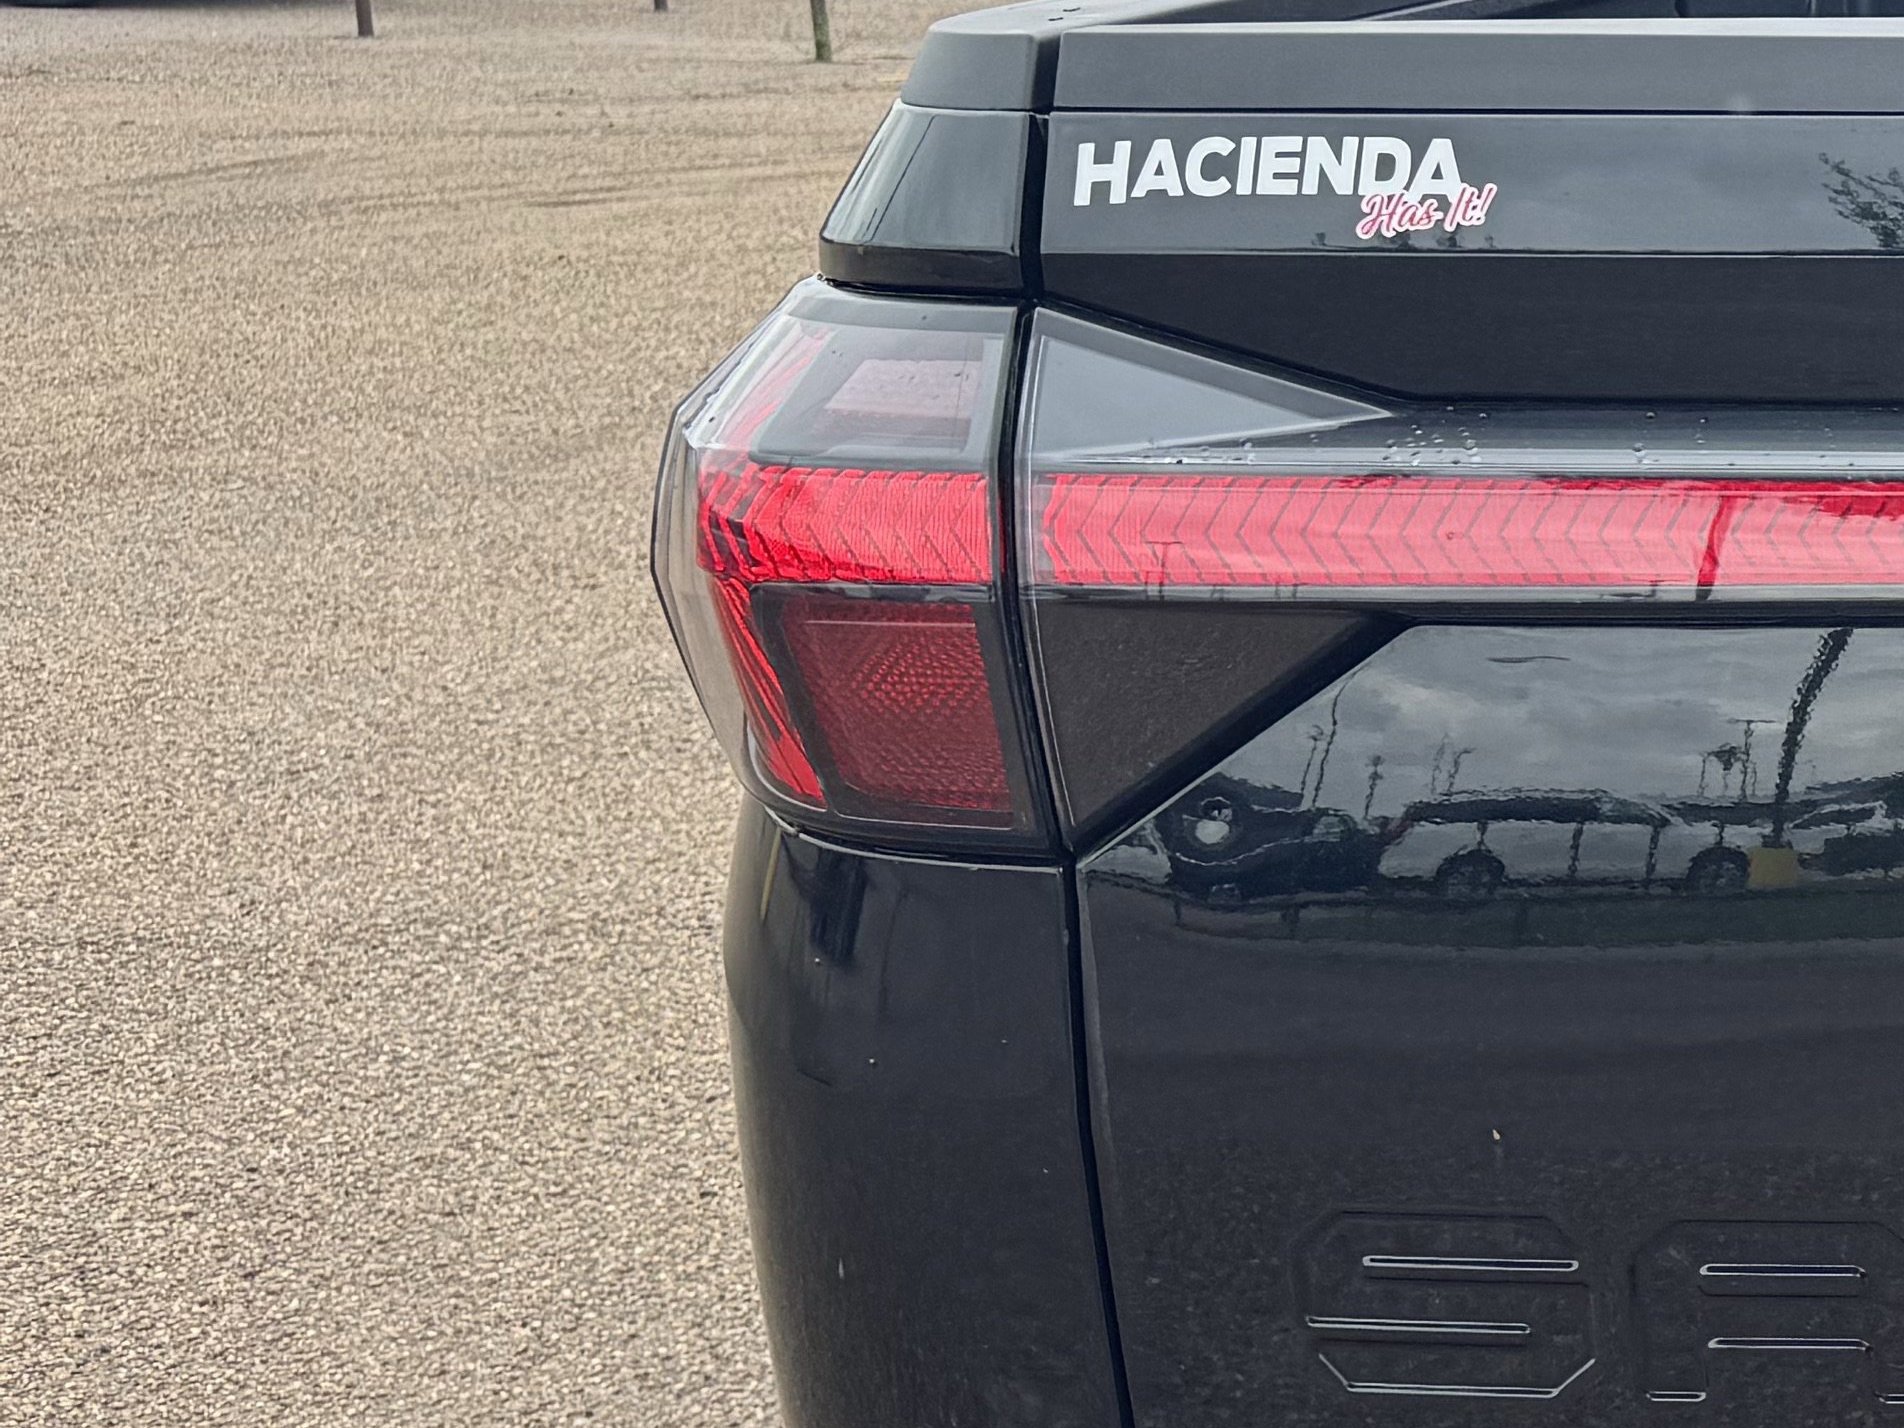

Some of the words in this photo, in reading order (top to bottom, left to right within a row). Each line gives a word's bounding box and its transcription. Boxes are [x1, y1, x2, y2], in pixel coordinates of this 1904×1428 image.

[1073, 135, 1464, 207] HACIENDA
[1356, 190, 1444, 240] Has
[1443, 183, 1498, 232] It!
